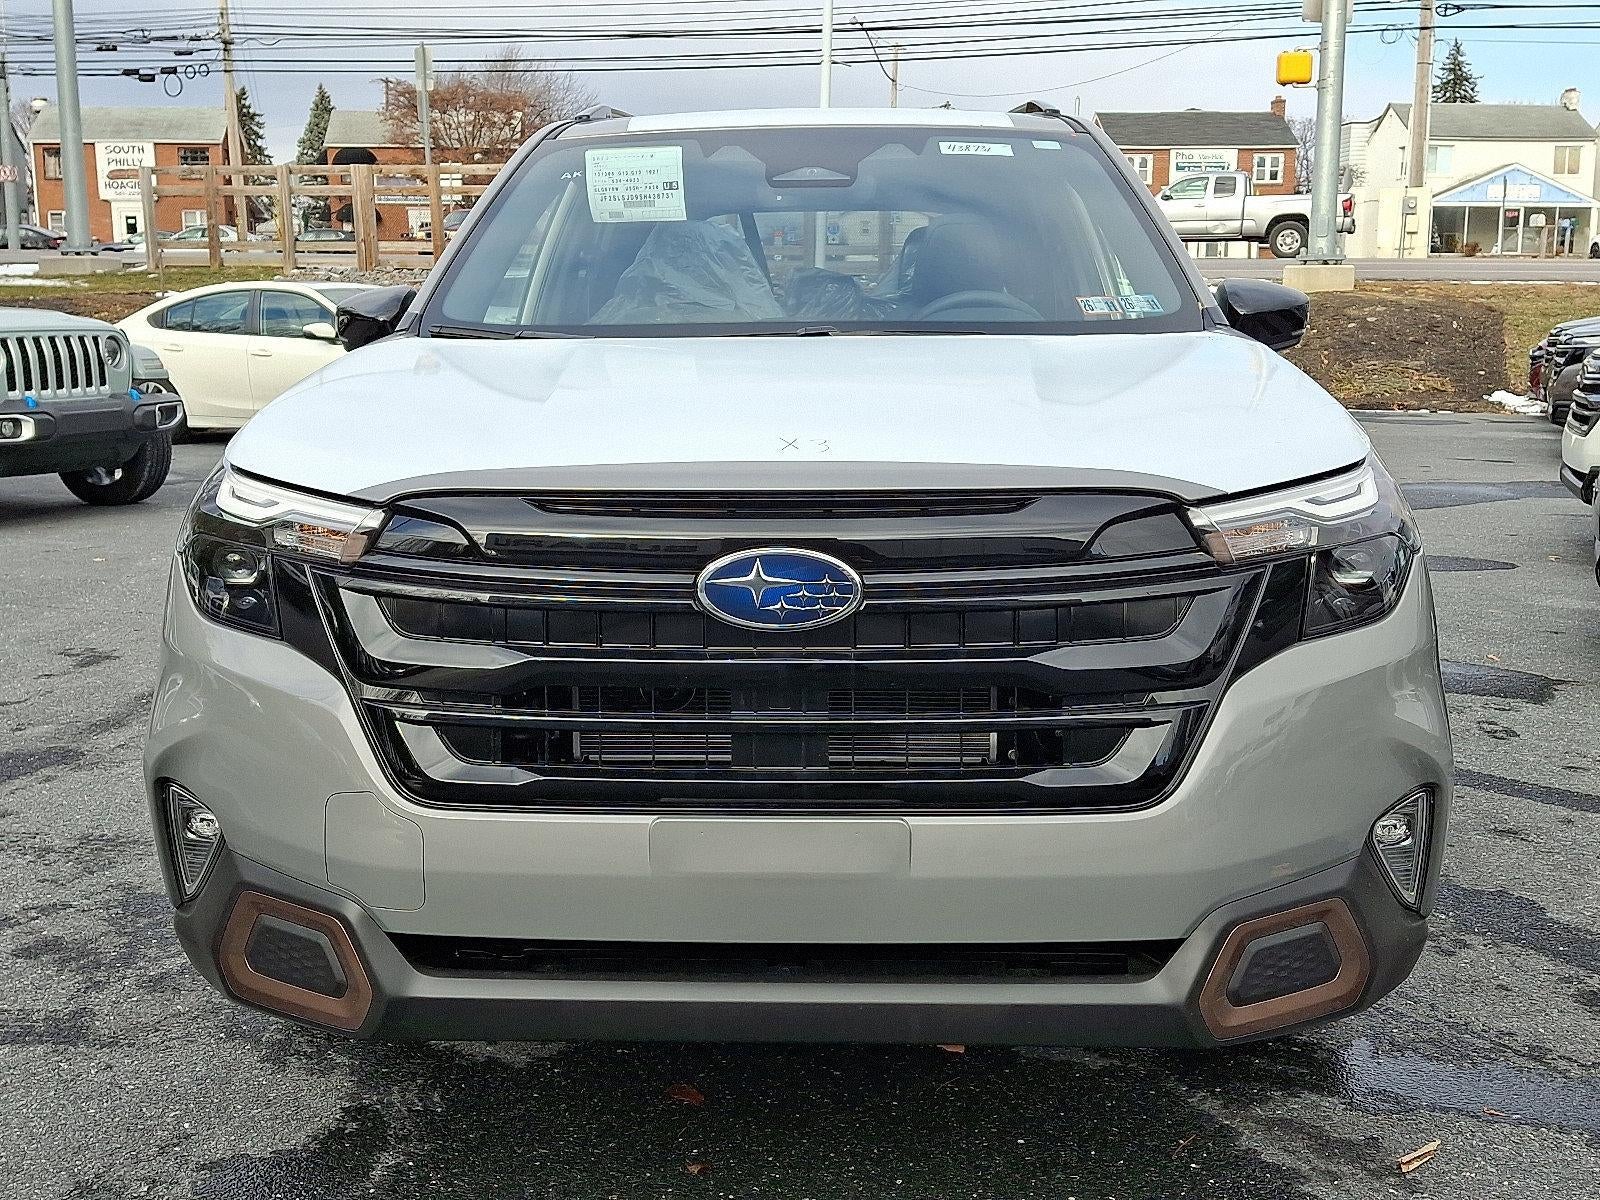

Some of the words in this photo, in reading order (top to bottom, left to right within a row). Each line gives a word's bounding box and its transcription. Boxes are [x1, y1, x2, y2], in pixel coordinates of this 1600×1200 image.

[104, 144, 145, 155] SOUTH
[1175, 151, 1194, 160] Pho
[107, 157, 143, 167] PHILLY
[1080, 299, 1095, 312] 26
[1121, 297, 1135, 310] 26
